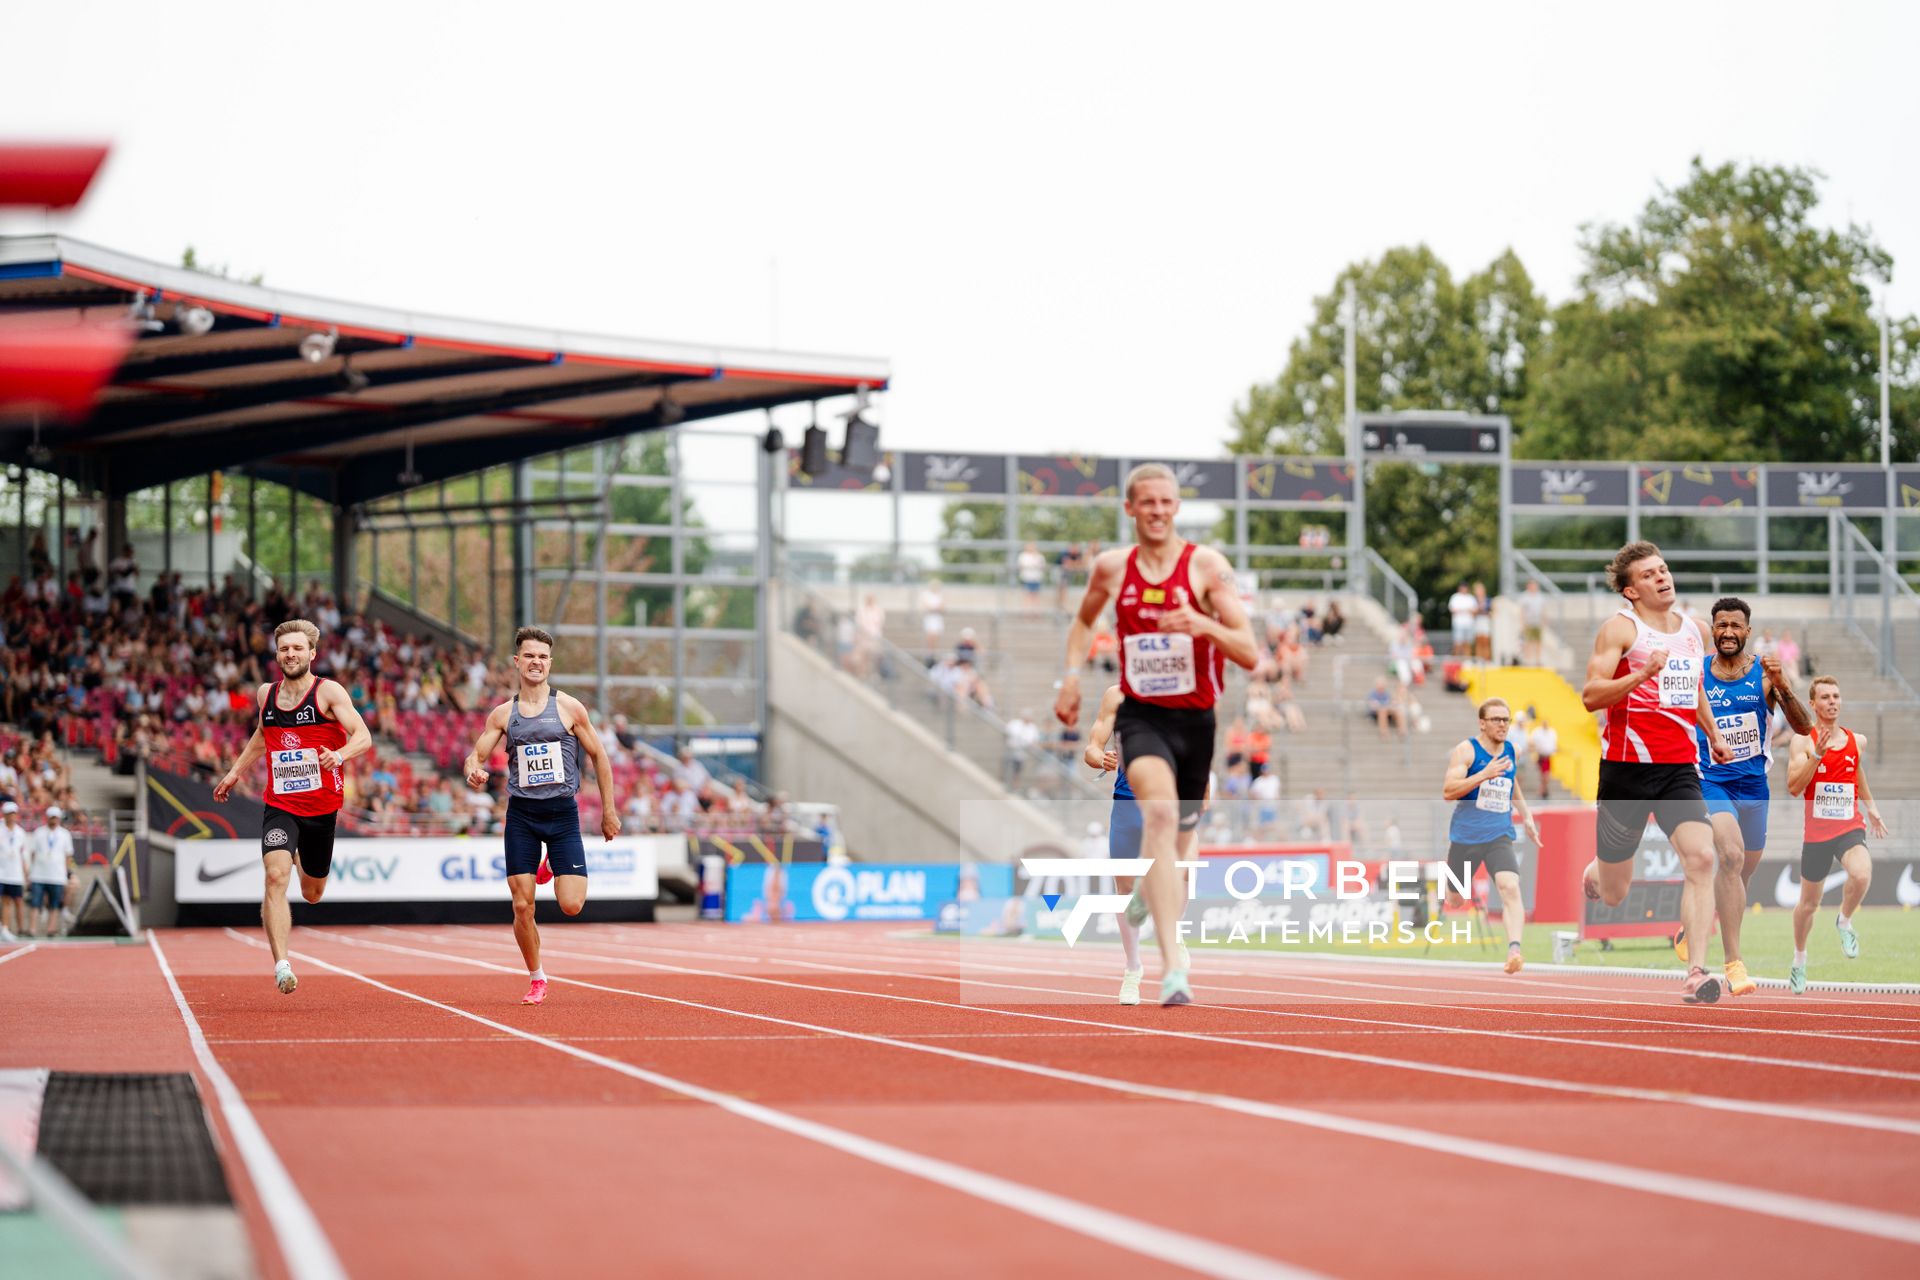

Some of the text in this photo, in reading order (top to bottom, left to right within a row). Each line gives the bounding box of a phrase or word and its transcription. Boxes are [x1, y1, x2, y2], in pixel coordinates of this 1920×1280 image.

[1138, 637, 1170, 651] GLS
[1132, 656, 1187, 676] SANDERS
[1669, 659, 1691, 671] GLS
[296, 710, 309, 721] OS
[1716, 715, 1743, 730] GLS
[1722, 728, 1759, 746] HNEIDER
[279, 750, 303, 763] GLS
[525, 745, 548, 756] GLS
[273, 762, 319, 780] DAMMERMANN
[527, 758, 553, 772] KLEI
[1824, 784, 1844, 793] GLS
[1815, 794, 1853, 807] BREITKOPF
[441, 855, 506, 881] GLS
[856, 871, 926, 902] PLAN
